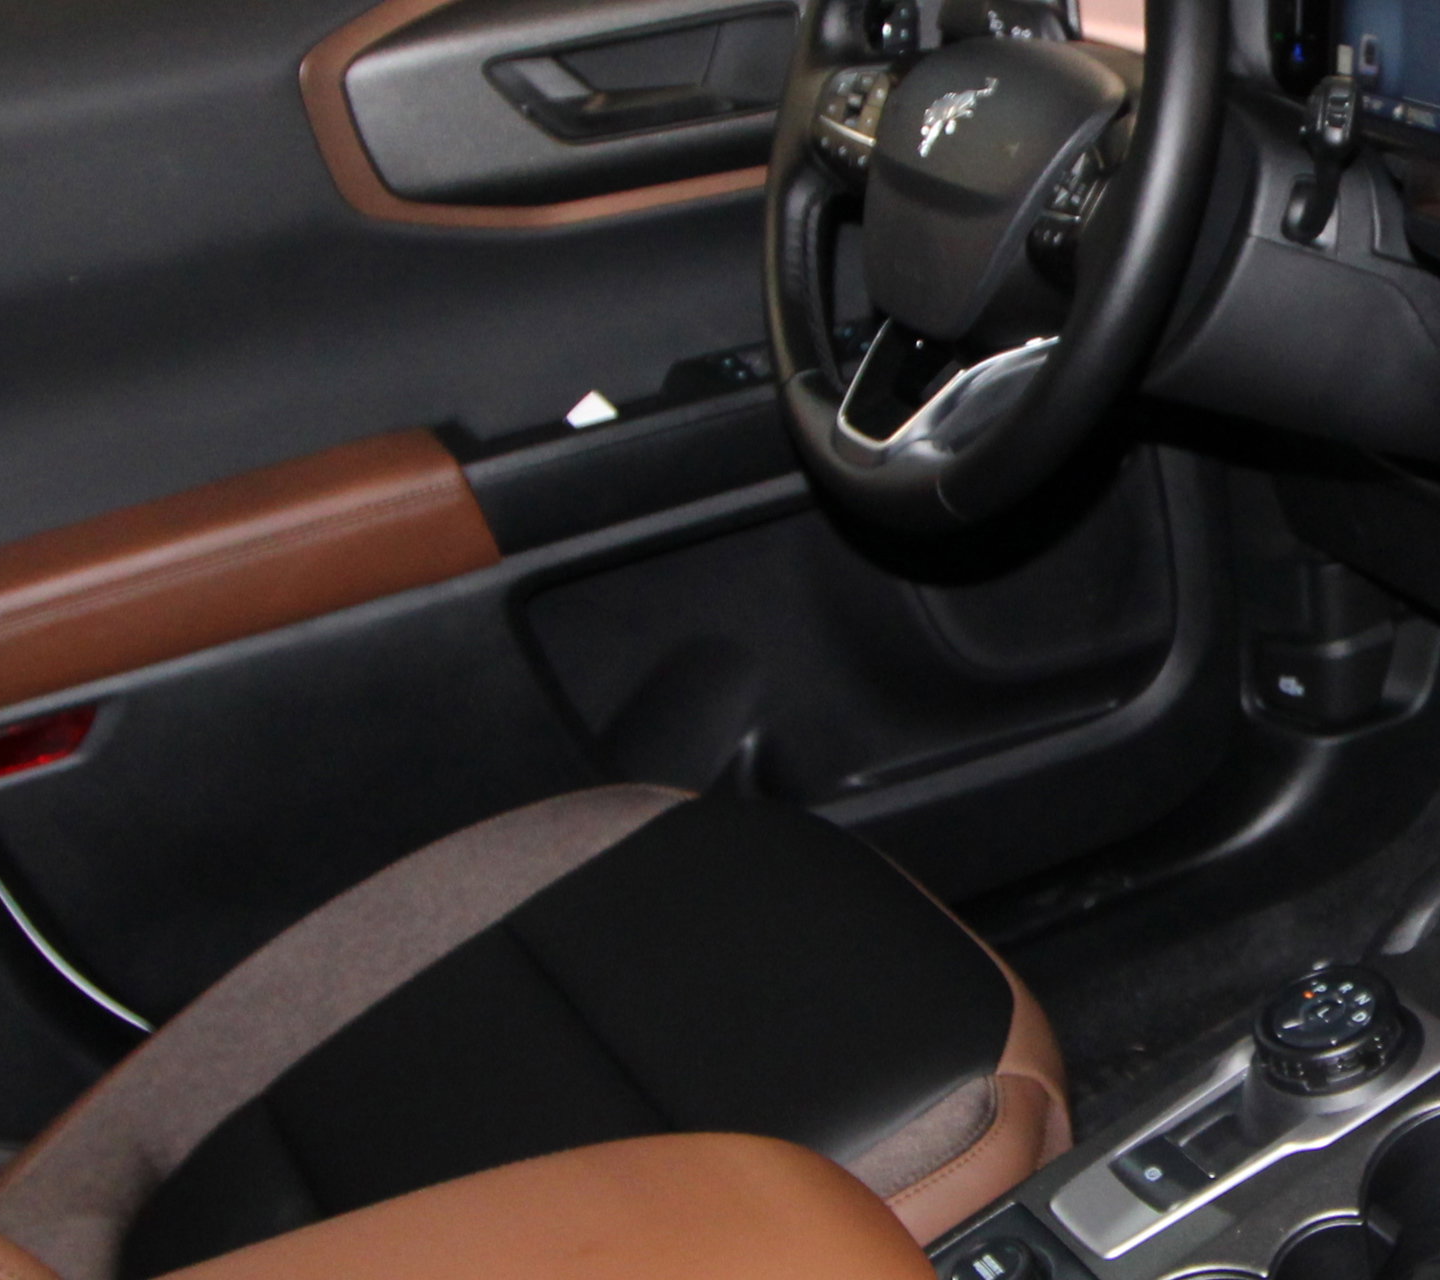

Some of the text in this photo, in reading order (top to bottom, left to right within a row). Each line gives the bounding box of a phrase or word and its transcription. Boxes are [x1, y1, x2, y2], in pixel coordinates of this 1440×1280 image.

[1313, 982, 1371, 1023] P R N D
